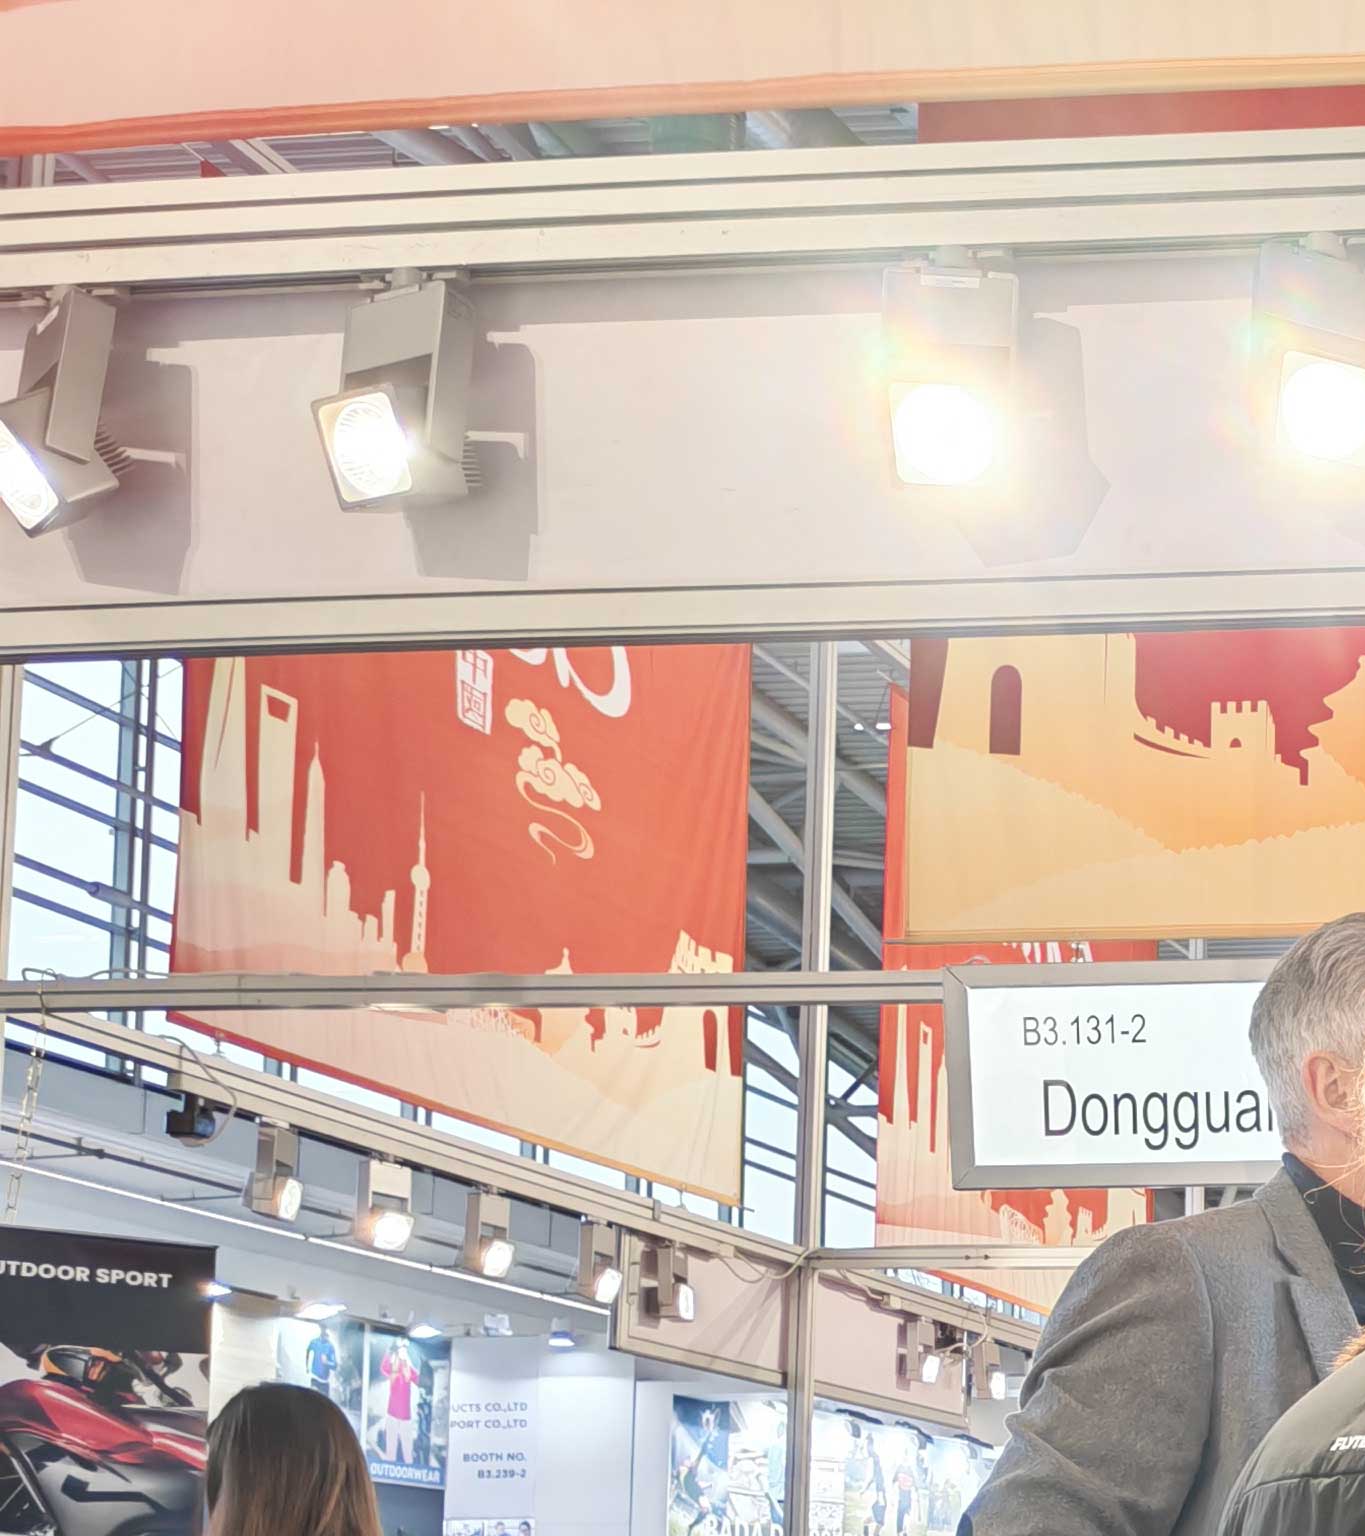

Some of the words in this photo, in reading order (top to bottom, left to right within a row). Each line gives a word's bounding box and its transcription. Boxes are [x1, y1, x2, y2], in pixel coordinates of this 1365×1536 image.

[1023, 1013, 1147, 1046] B3.131-2
[96, 1268, 173, 1288] SPORT
[452, 1403, 480, 1412] UCTS
[450, 1420, 480, 1429] PORT
[463, 1453, 503, 1462] BOOTH
[507, 1452, 526, 1461] NO.
[370, 1462, 441, 1483] OUTDOORWEAR
